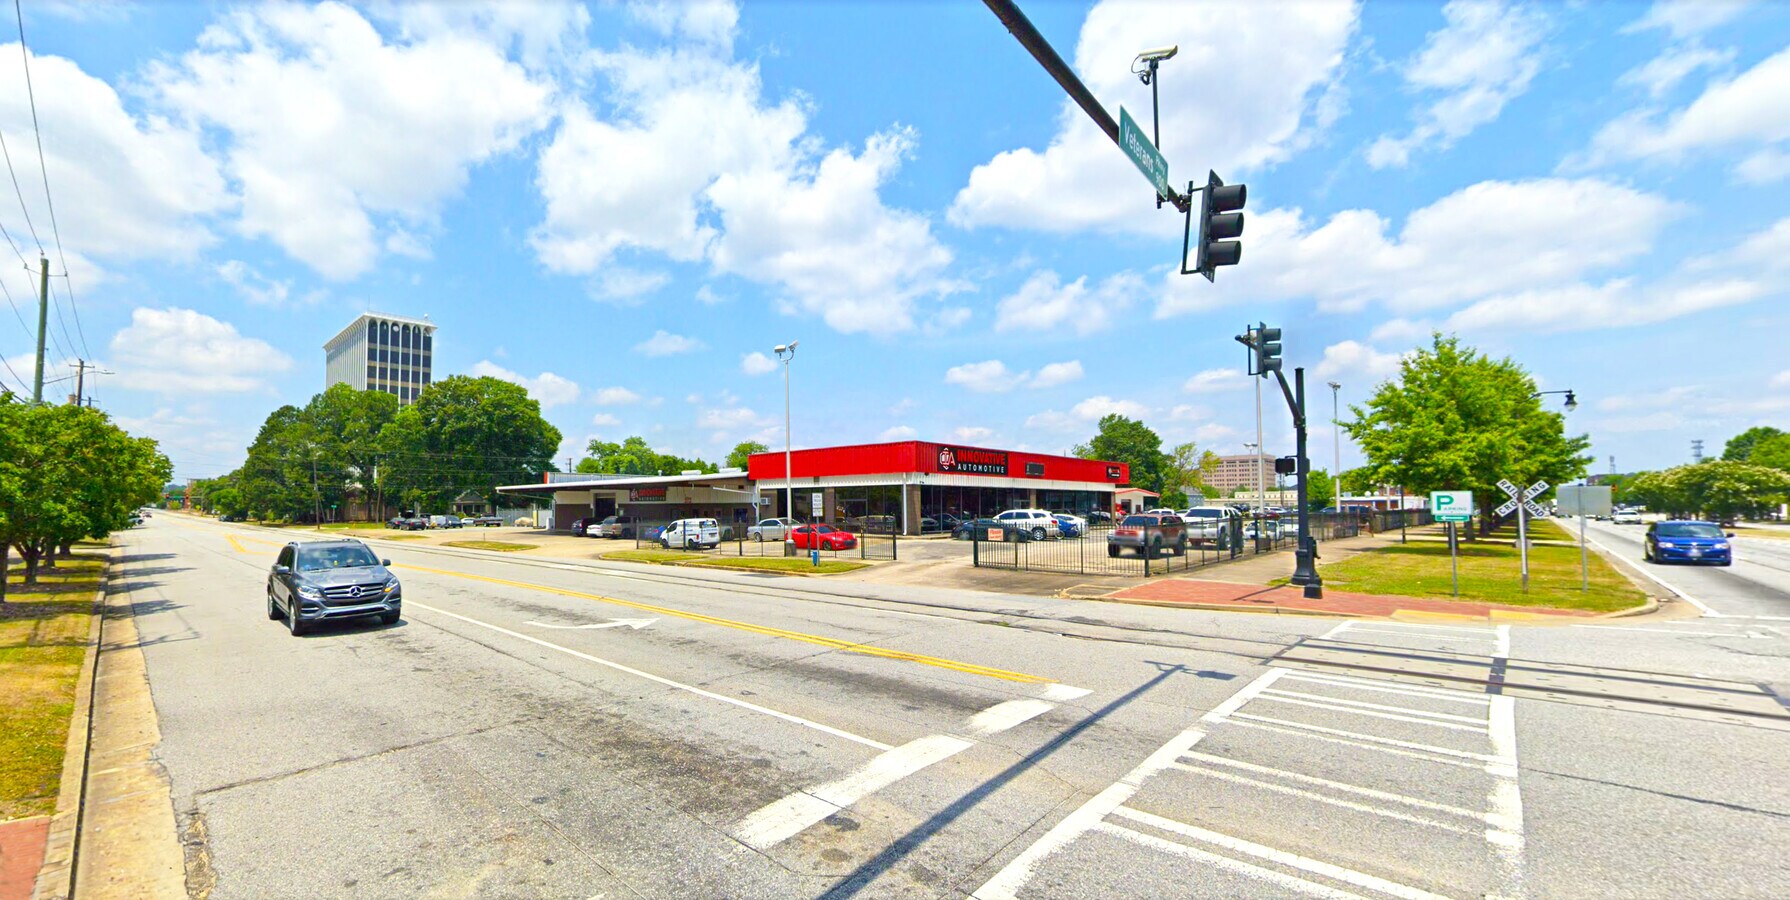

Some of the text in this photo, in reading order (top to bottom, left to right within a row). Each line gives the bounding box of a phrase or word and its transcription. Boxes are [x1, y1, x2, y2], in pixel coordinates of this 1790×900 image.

[1124, 121, 1153, 173] Veterans
[957, 449, 1005, 465] INNOVATIVE
[957, 463, 1004, 474] AUTOMOTIVE
[1499, 480, 1545, 517] RAIL ROAD
